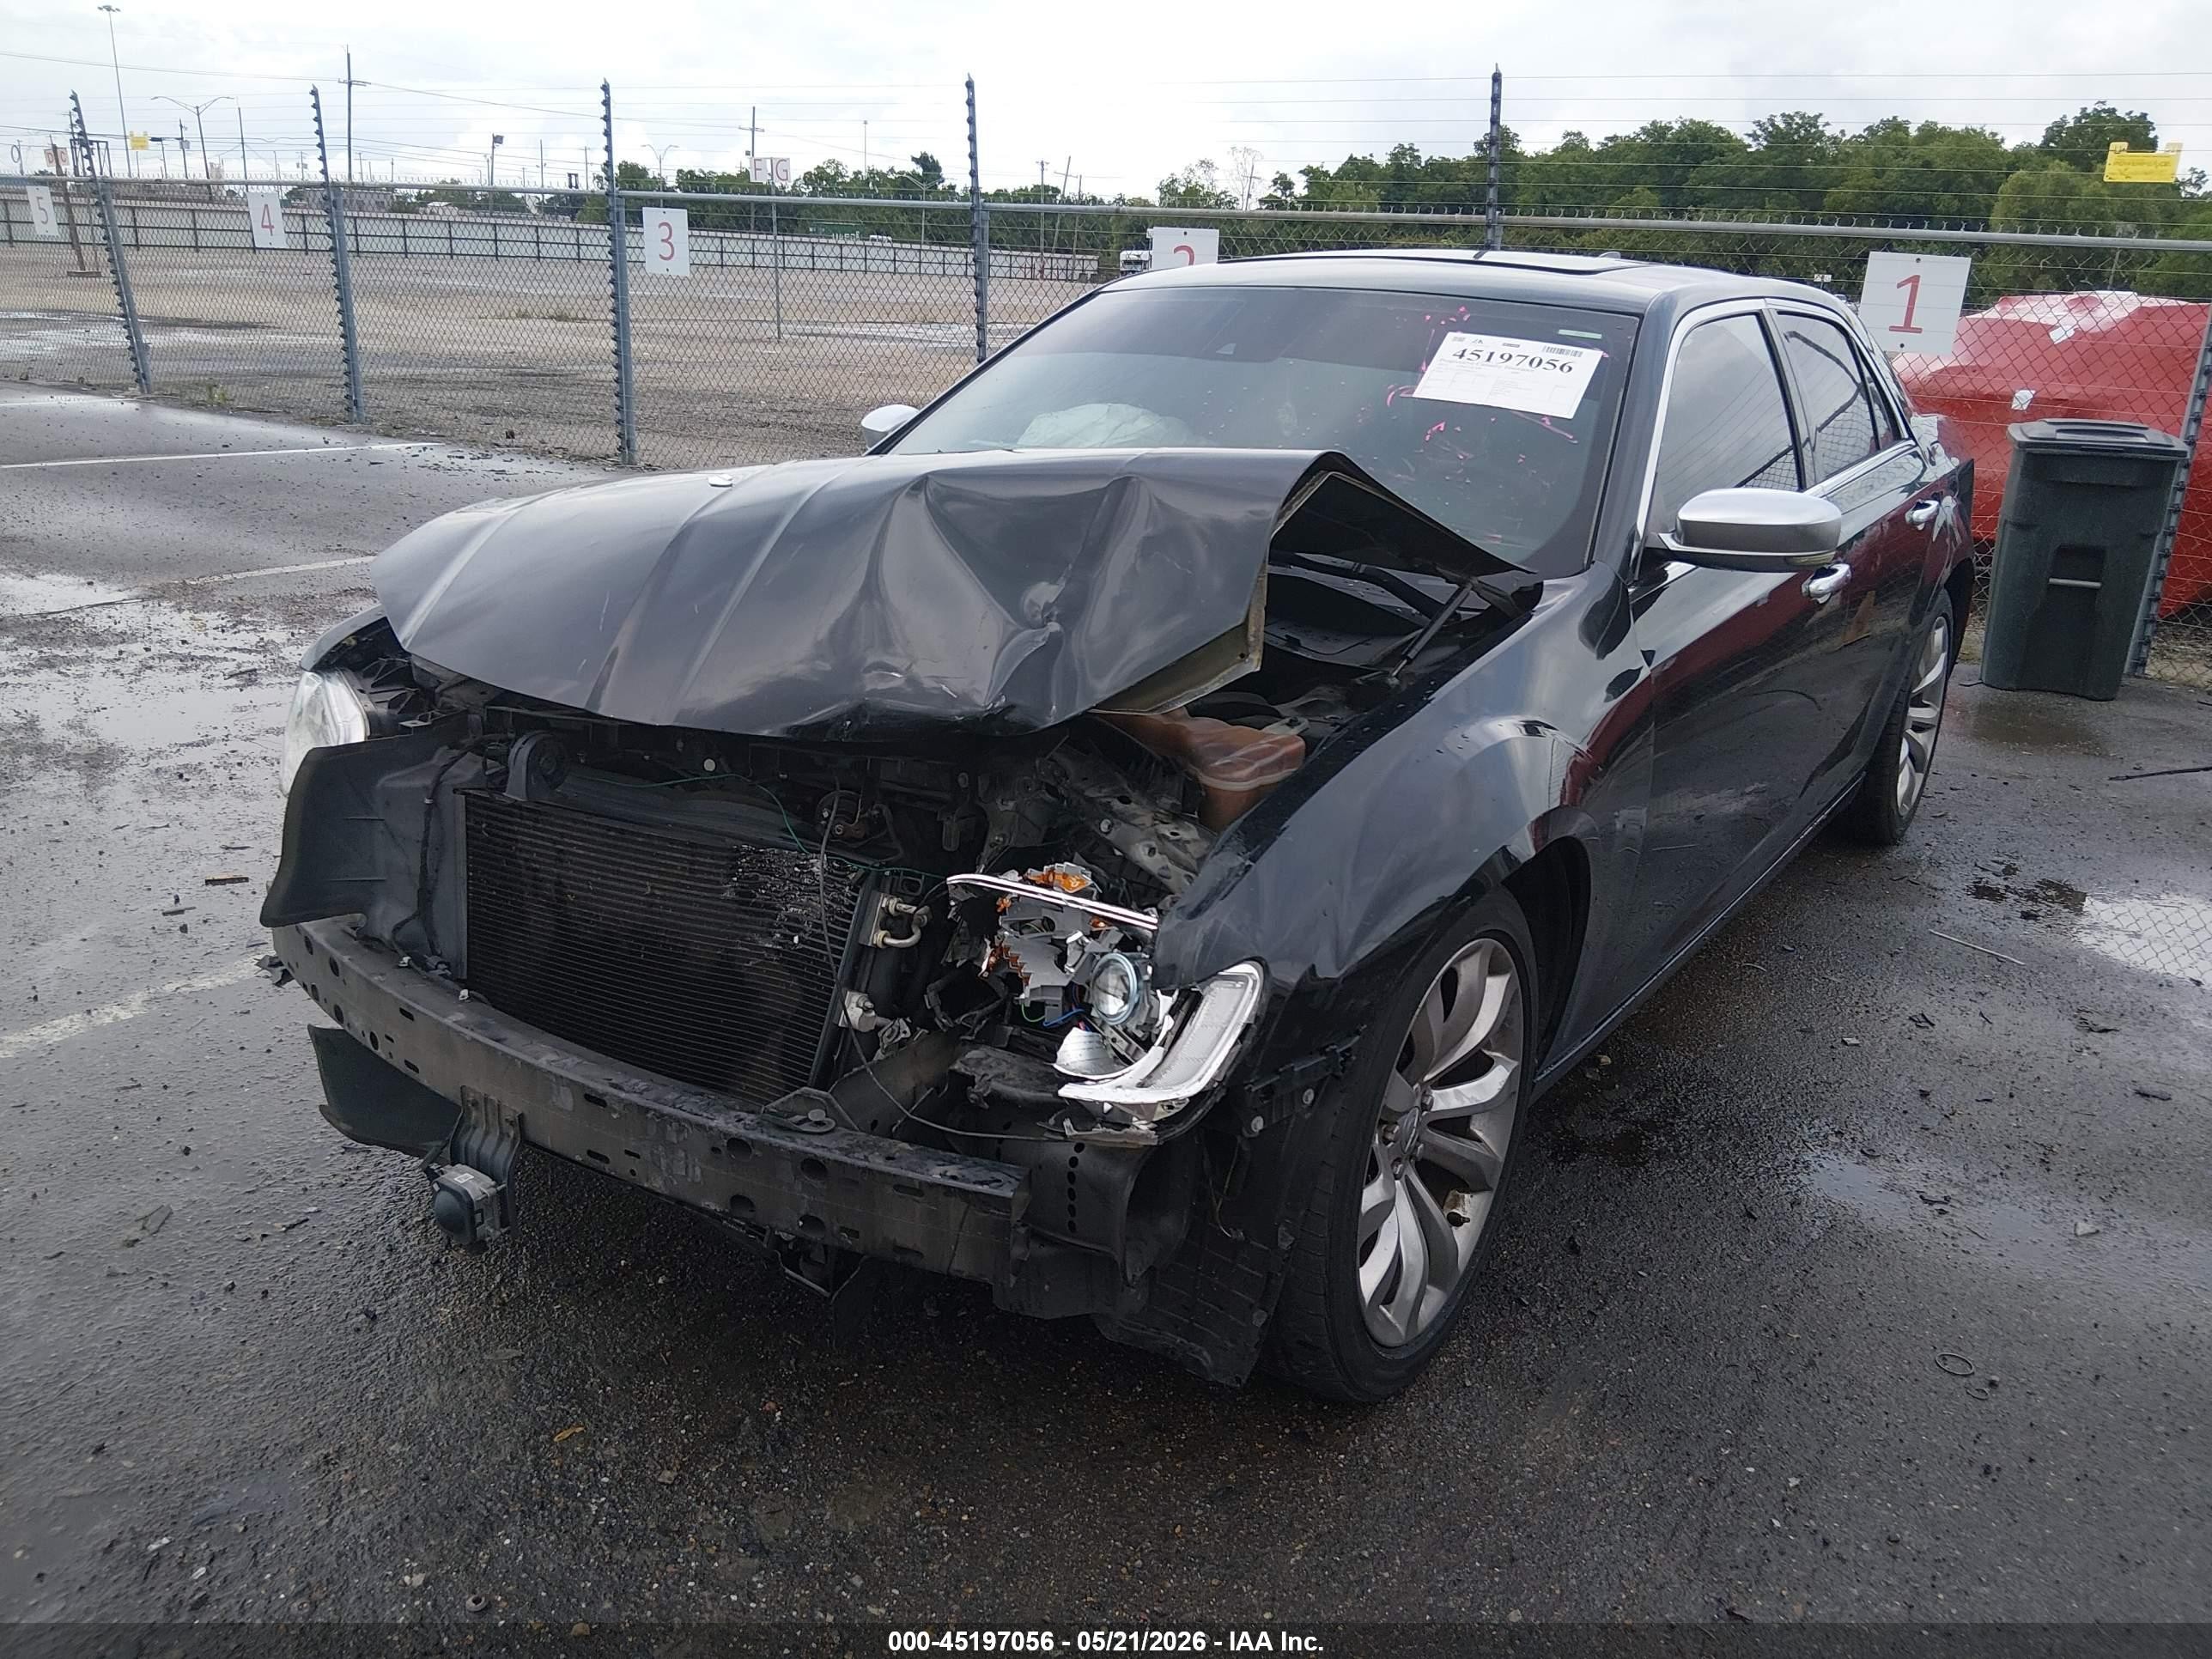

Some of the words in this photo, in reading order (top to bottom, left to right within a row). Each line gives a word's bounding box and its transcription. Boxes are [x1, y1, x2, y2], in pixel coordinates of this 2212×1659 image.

[753, 159, 763, 181] F
[775, 159, 789, 181] G
[35, 196, 49, 225] 5
[261, 204, 275, 236] 4
[658, 222, 675, 261] 3
[1888, 274, 1923, 334] 1
[1452, 348, 1574, 374] 45197056
